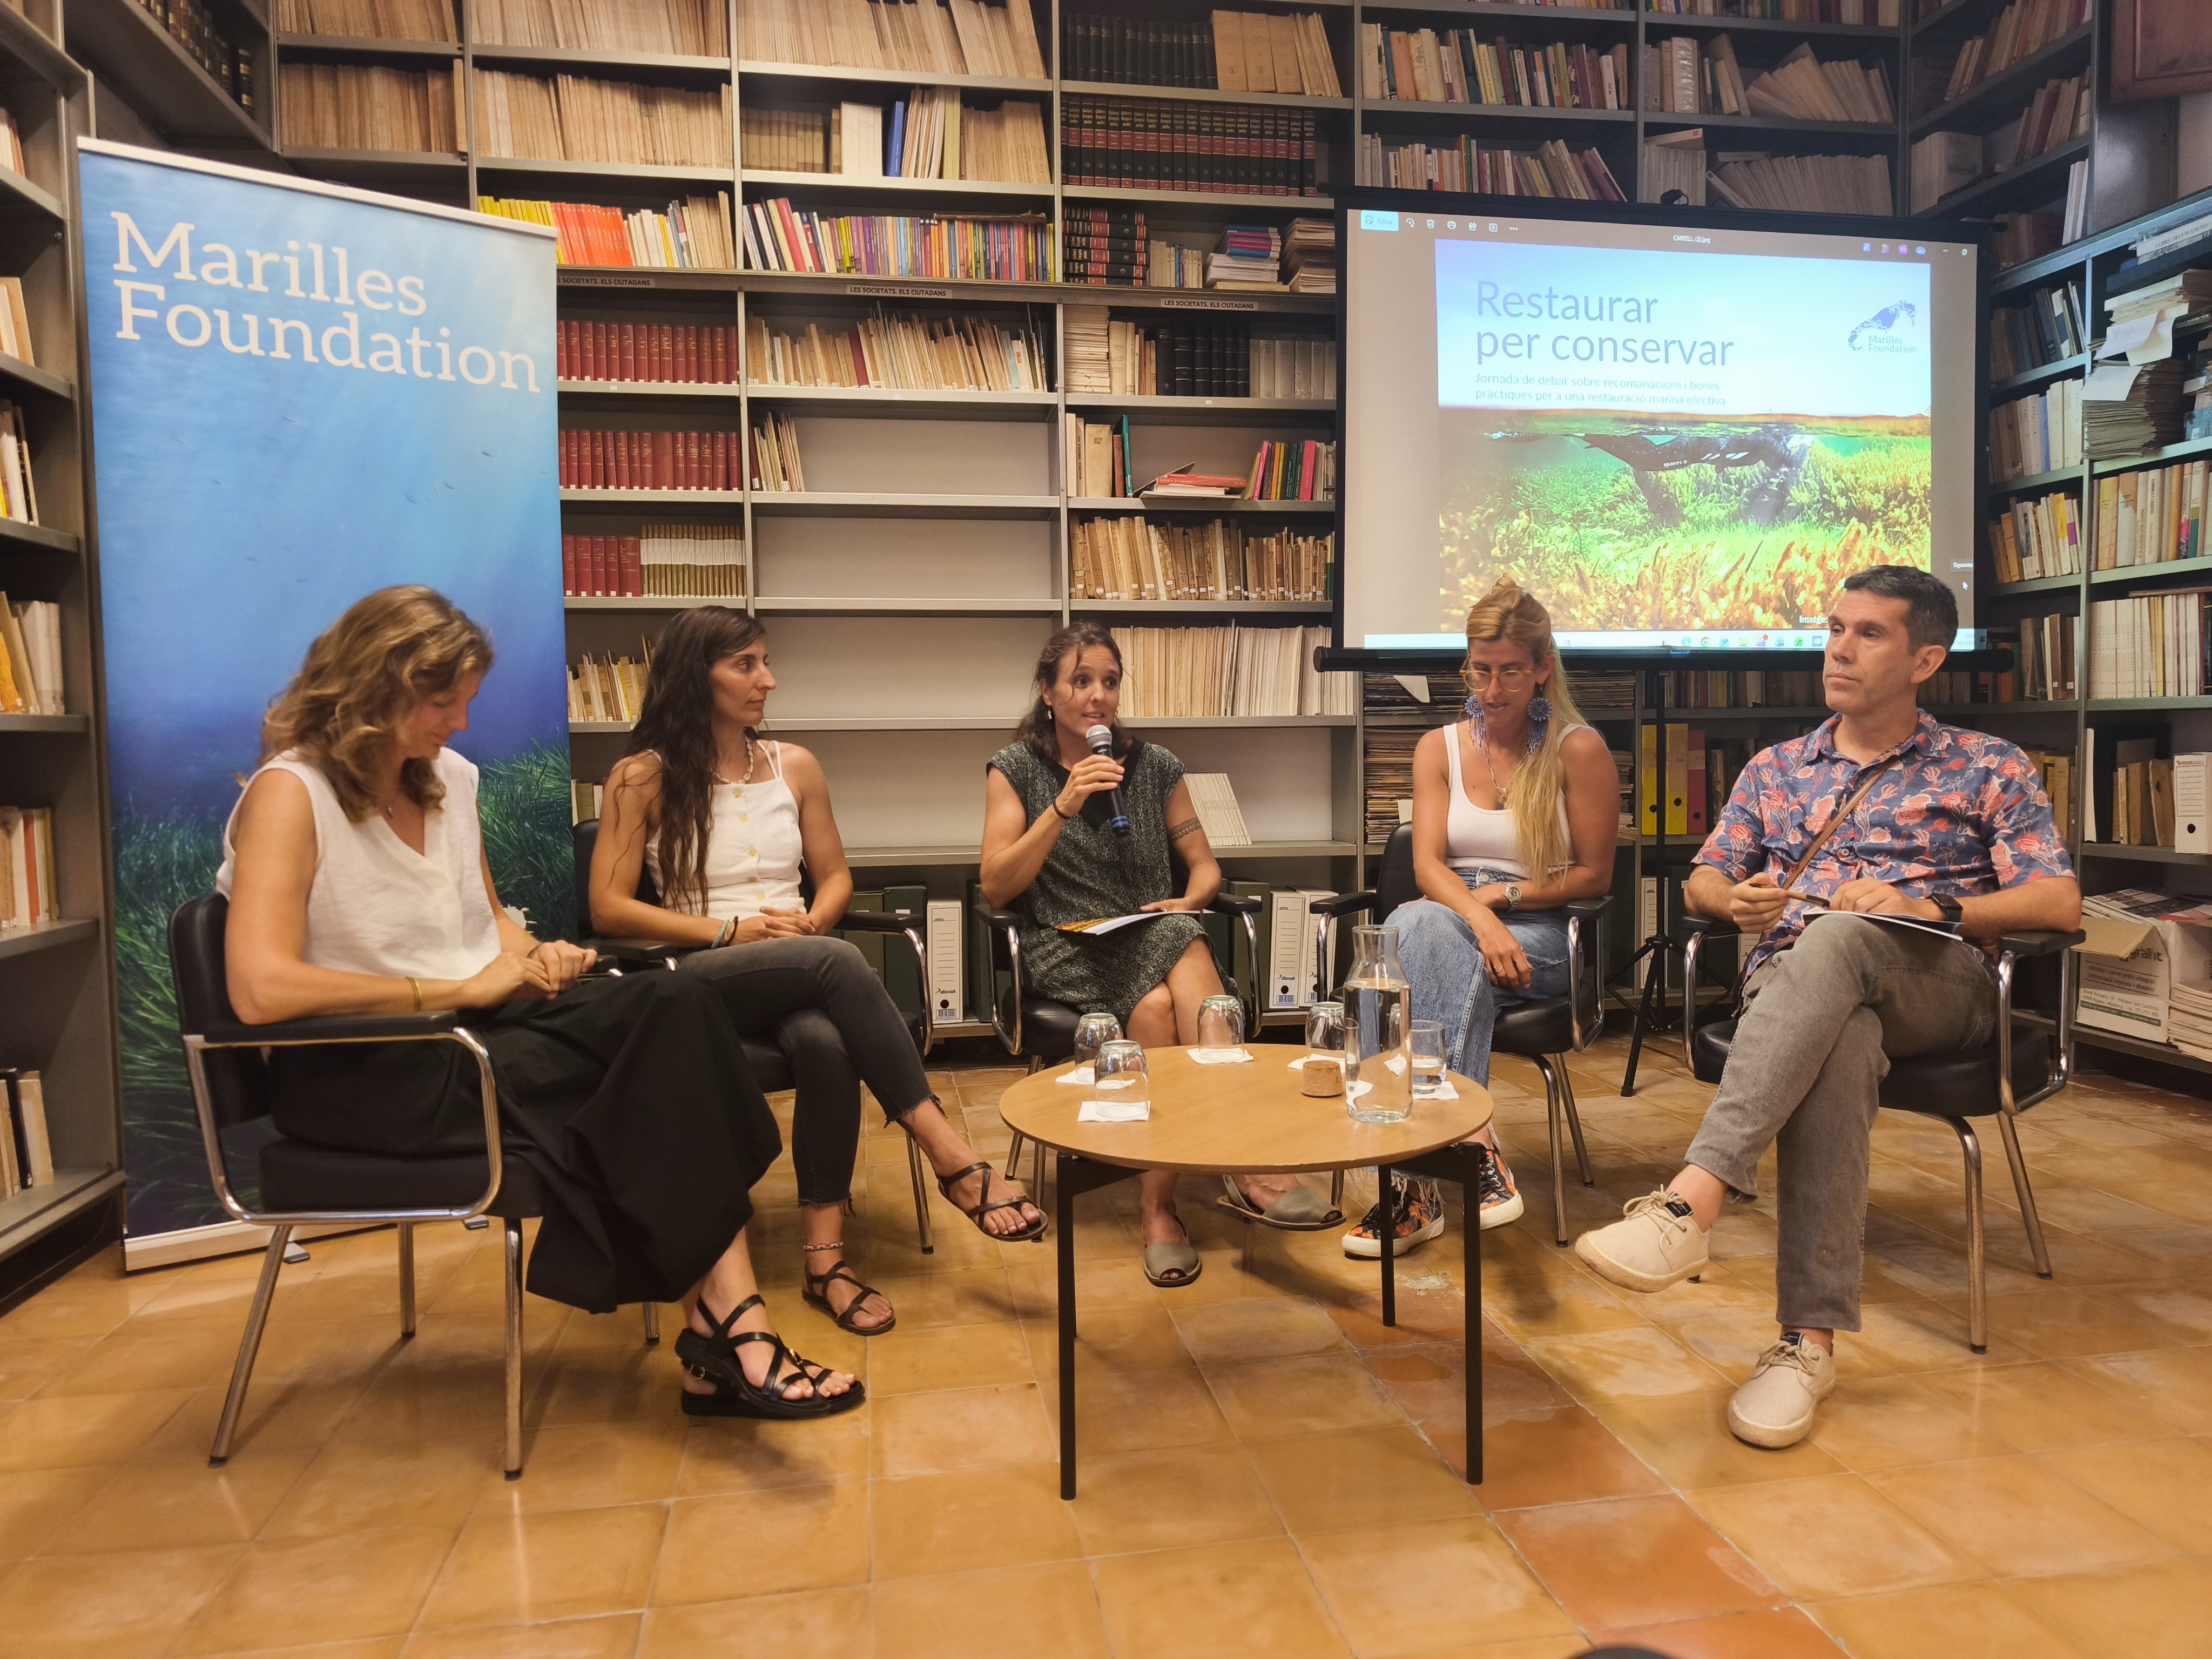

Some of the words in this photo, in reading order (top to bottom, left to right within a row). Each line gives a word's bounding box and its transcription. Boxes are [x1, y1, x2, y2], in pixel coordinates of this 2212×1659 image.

[111, 211, 427, 316] Marilles
[1477, 280, 1658, 323] Restaurar
[114, 279, 540, 393] Foundation
[1477, 332, 1540, 365] per
[1552, 335, 1734, 366] conservar
[1869, 335, 1903, 344] Marilles
[1869, 344, 1916, 353] Foundation
[1475, 373, 1519, 385] Jornada
[1523, 374, 1534, 385] de
[1539, 375, 1568, 386] debat
[1572, 376, 1600, 388] sobre
[1604, 378, 1681, 390] recomanacions
[1684, 380, 1687, 389] i
[1690, 381, 1719, 391] bones
[1475, 388, 1532, 401] pràctiques
[1536, 392, 1553, 402] per
[1556, 393, 1561, 401] a
[1565, 393, 1584, 402] una
[1588, 393, 1645, 403] restauració
[1649, 395, 1683, 404] marina
[1687, 395, 1725, 406] efectiva
